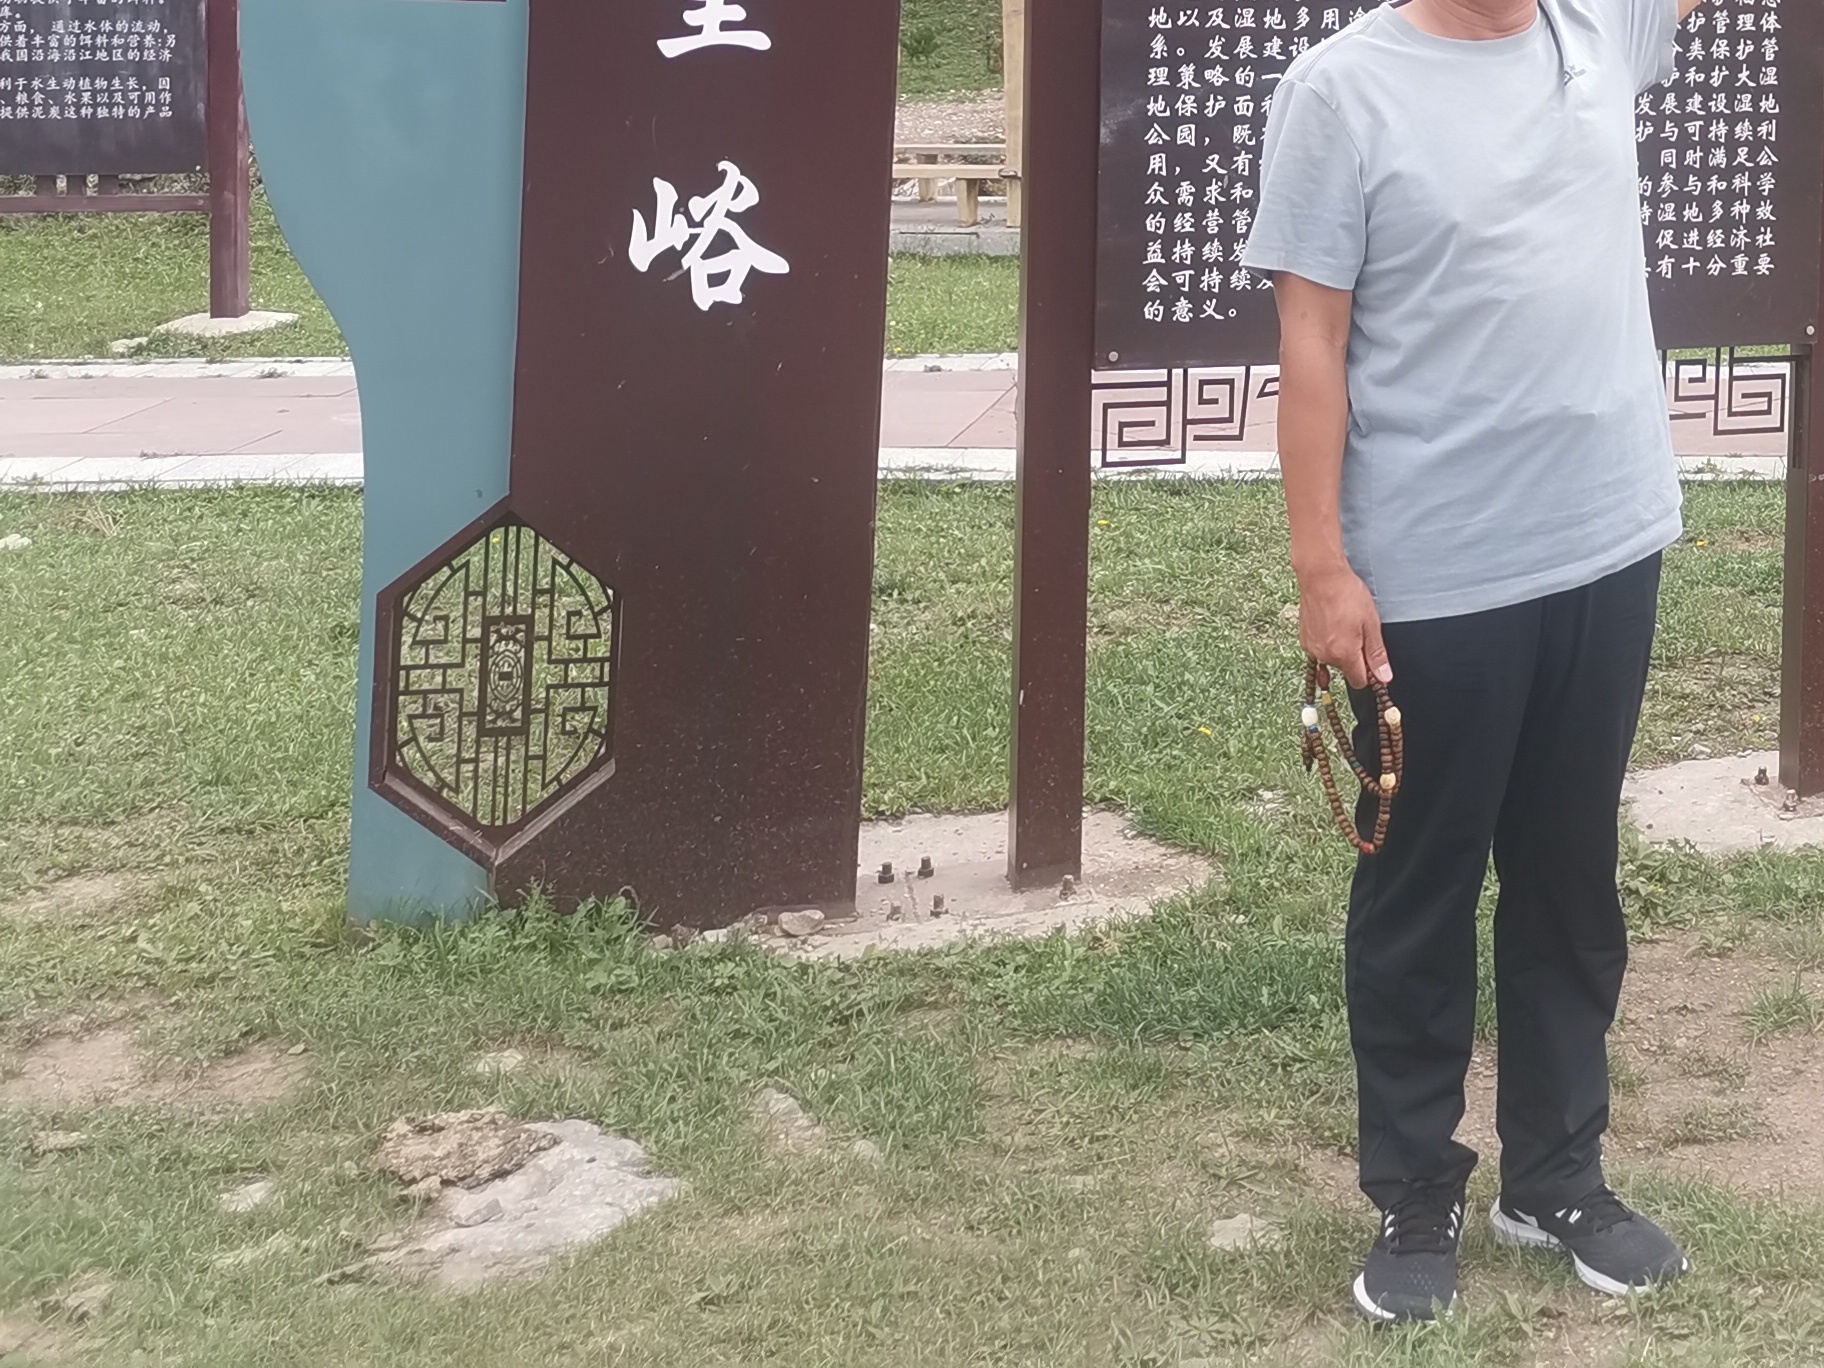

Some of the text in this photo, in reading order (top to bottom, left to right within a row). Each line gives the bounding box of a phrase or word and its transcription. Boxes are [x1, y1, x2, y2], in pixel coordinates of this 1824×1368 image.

[1677, 9, 1781, 34] 护管理体
[1150, 34, 1322, 60] 系。发展建设
[1144, 123, 1266, 148] 公园，既
[1145, 179, 1253, 206] 众需求和
[1656, 225, 1775, 250] 促进经济社
[1144, 297, 1236, 322] 的意义。
